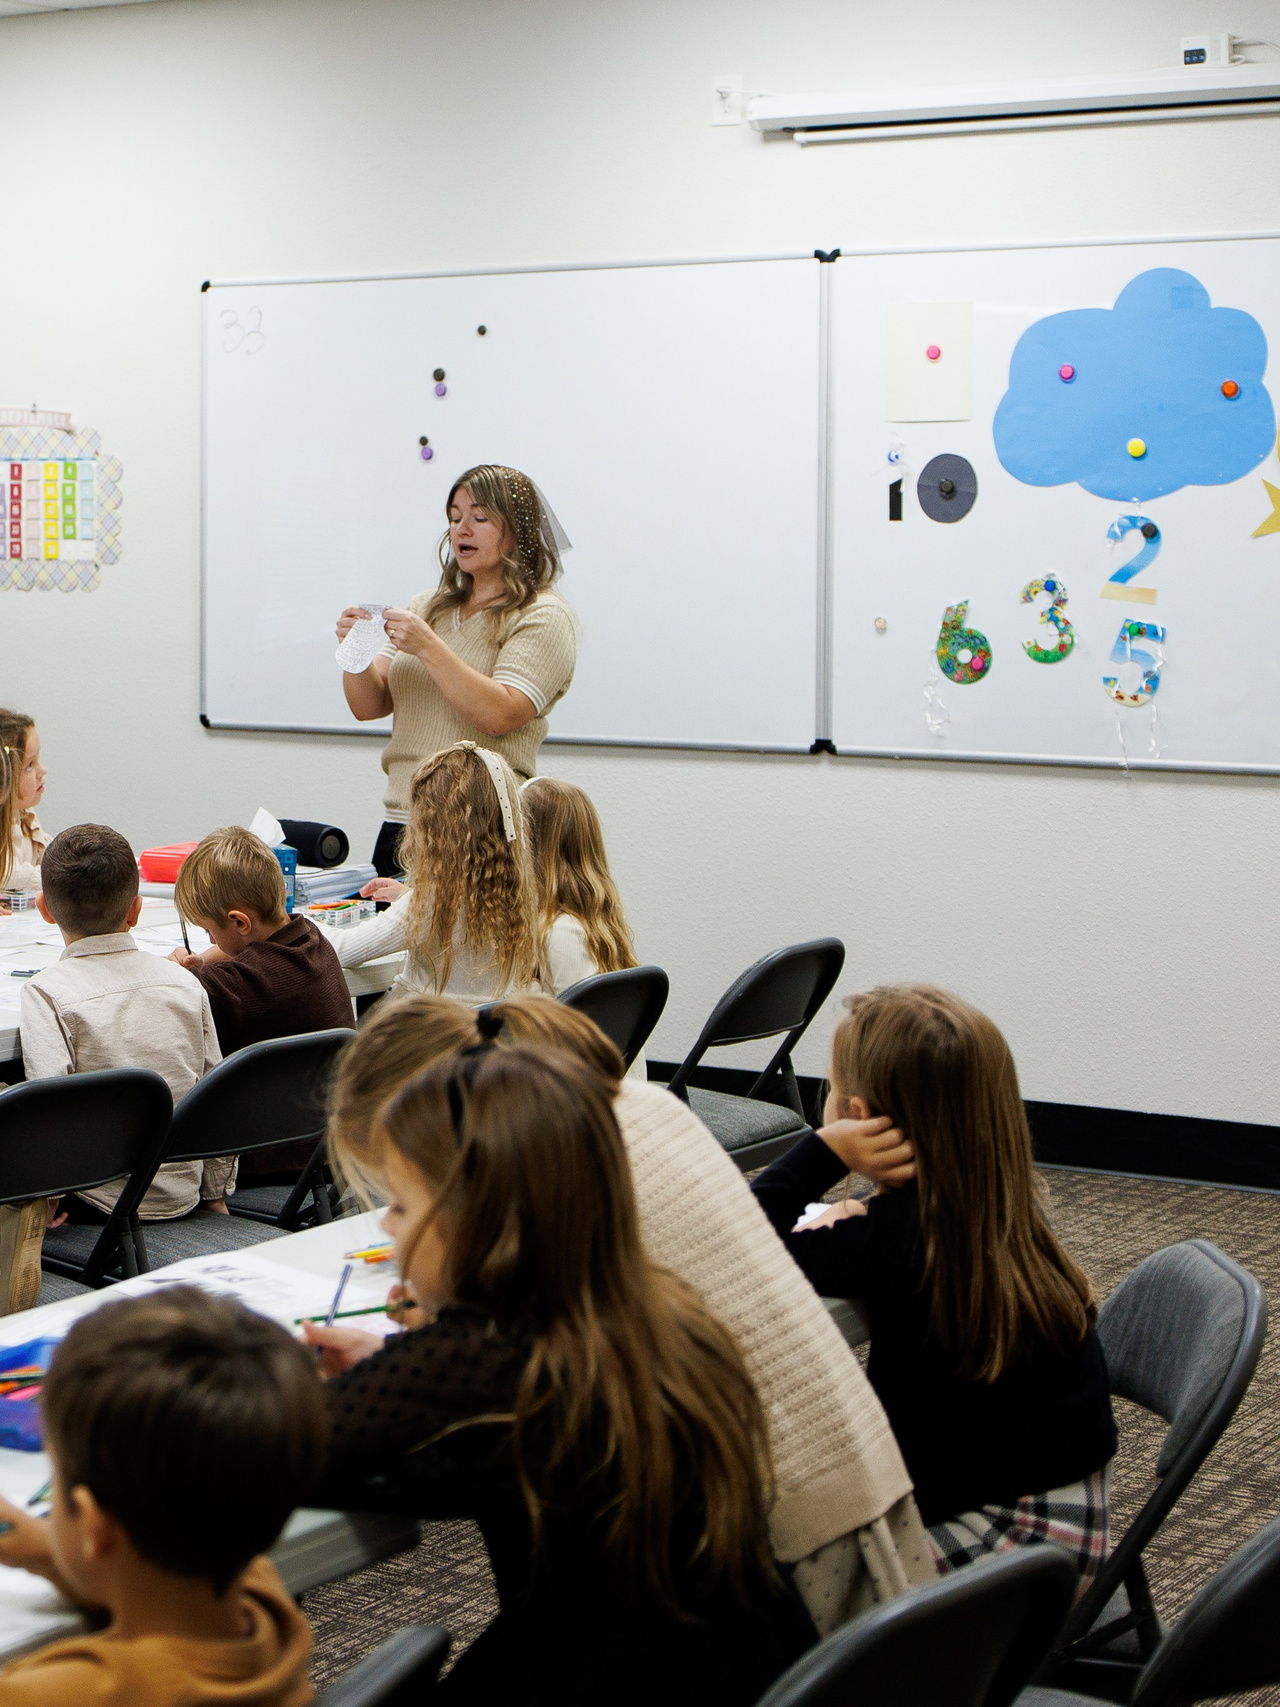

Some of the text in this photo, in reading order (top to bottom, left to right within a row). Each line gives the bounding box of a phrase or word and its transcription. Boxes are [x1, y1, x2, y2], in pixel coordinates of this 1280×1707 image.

[1100, 514, 1163, 605] 2
[936, 600, 994, 685] 6
[1020, 574, 1075, 664] 3
[1102, 618, 1167, 708] 5
